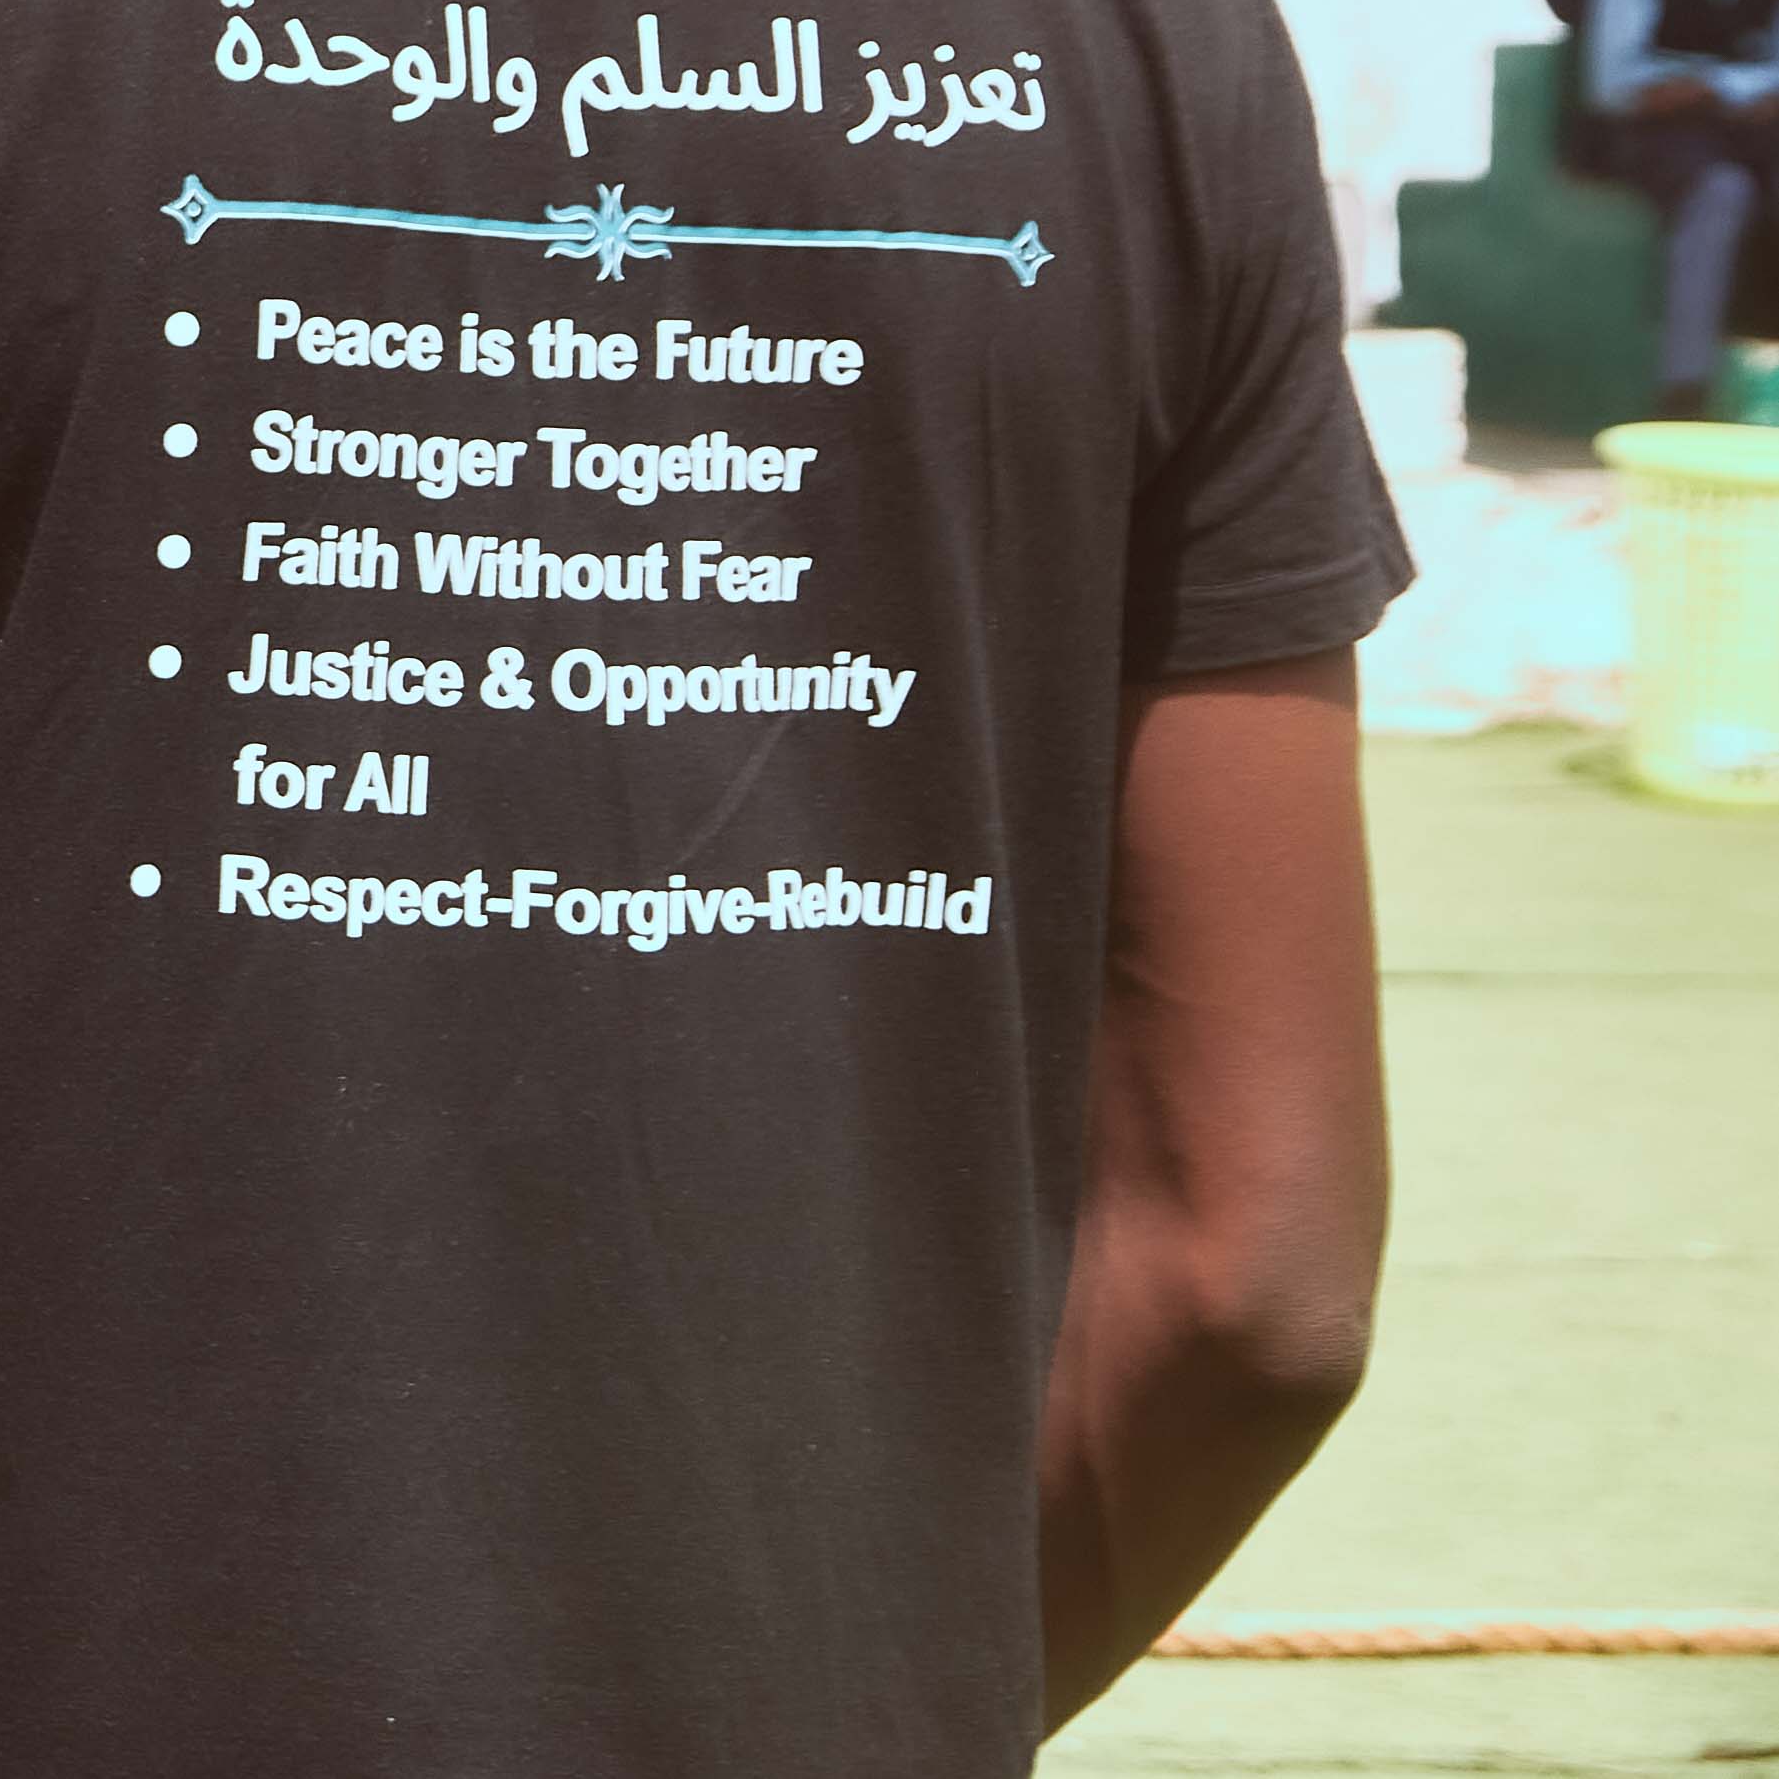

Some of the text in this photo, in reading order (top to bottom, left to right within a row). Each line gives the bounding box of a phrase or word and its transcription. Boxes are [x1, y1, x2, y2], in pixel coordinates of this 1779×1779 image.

[561, 13, 823, 158] السلم
[846, 40, 1046, 148] تعزيز
[257, 298, 864, 386] Peace is the Future
[250, 409, 818, 506] Stronger Together
[242, 521, 813, 603] Faith Without Fear
[227, 633, 917, 728] Justice & Opportunity
[232, 743, 429, 816] for All
[218, 853, 993, 953] Respect-Forgive-Rebuild
